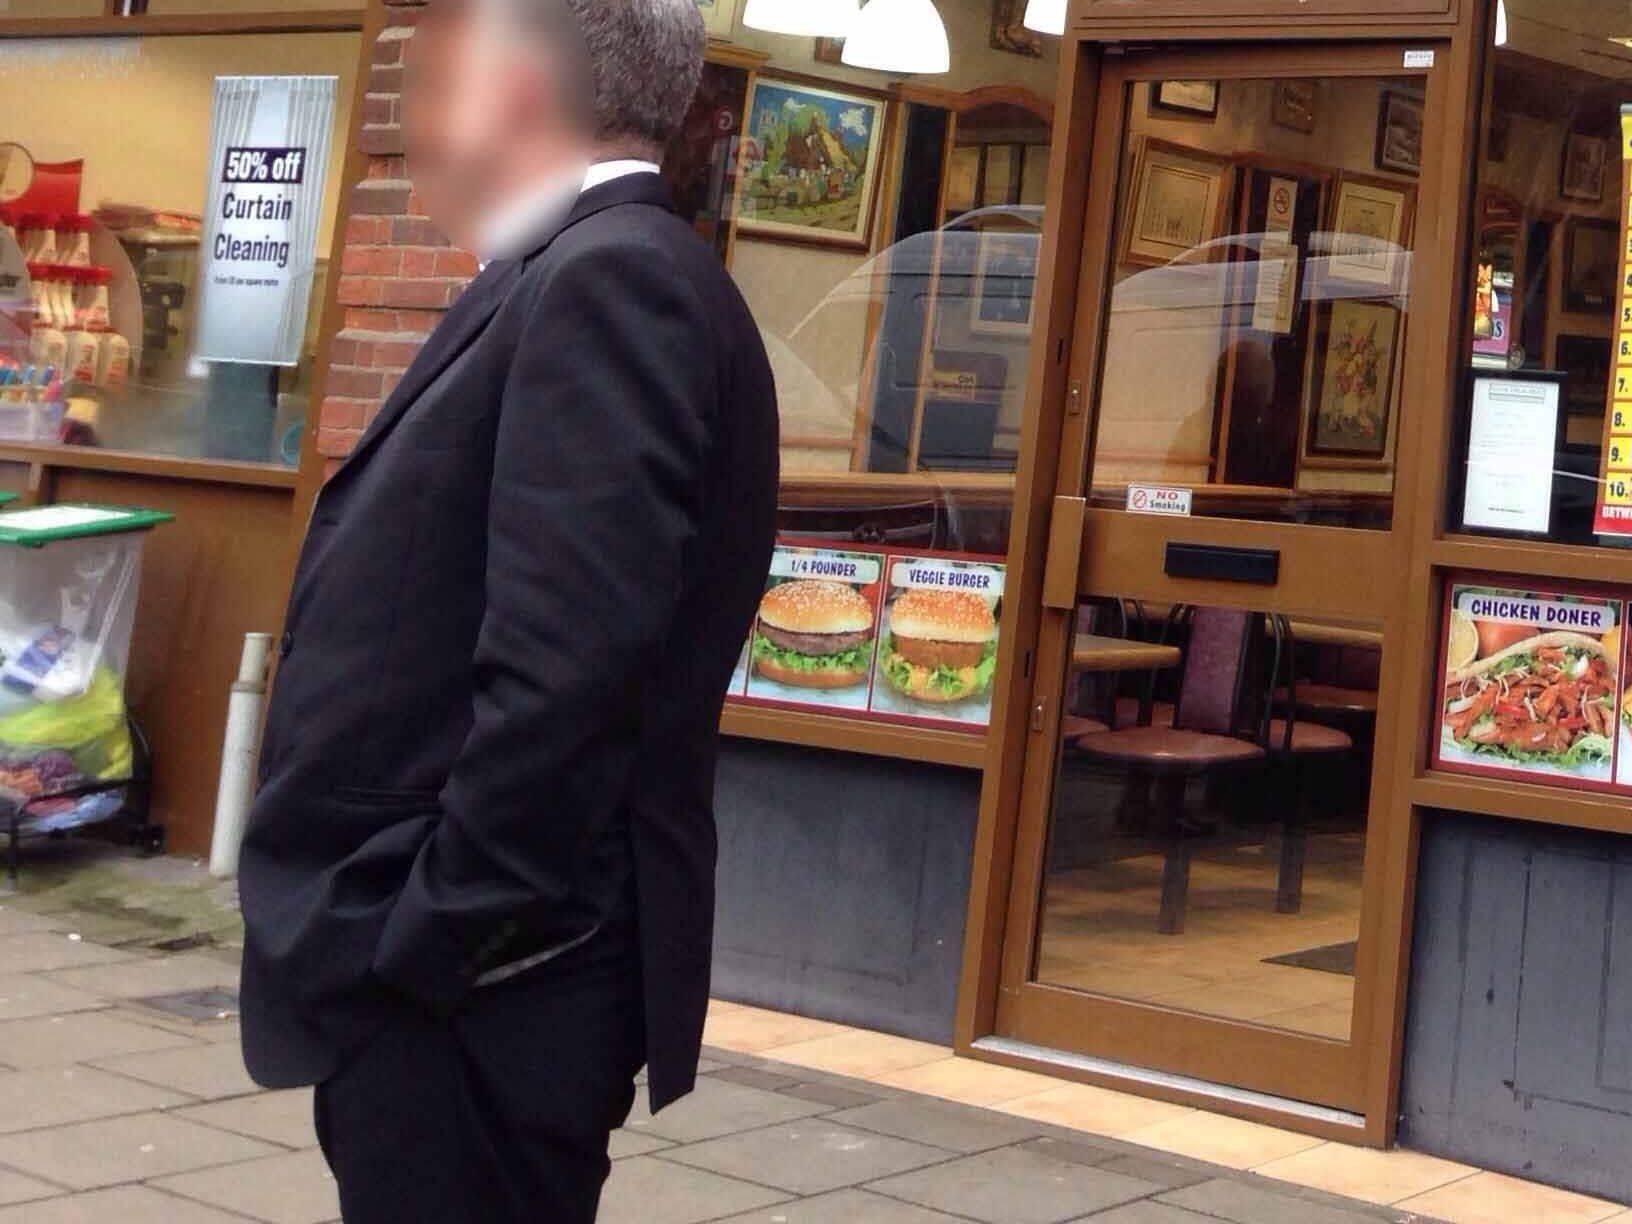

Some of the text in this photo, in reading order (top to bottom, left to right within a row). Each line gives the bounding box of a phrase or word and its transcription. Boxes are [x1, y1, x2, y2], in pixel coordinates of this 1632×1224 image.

[227, 150, 301, 181] 50% off
[222, 191, 293, 220] Curtain
[214, 233, 290, 268] Cleaning
[1620, 341, 1632, 356] 6.
[1618, 378, 1628, 393] 7.
[1614, 411, 1626, 427] 8.
[1611, 447, 1623, 462] 9.
[1155, 490, 1179, 500] NO
[1609, 481, 1629, 498] 10.
[1149, 499, 1186, 512] Smoking
[791, 559, 857, 577] 1/4 POUNDER
[909, 568, 990, 589] VEGGIE BURGER
[1471, 598, 1602, 627] CHICKEN DONER
